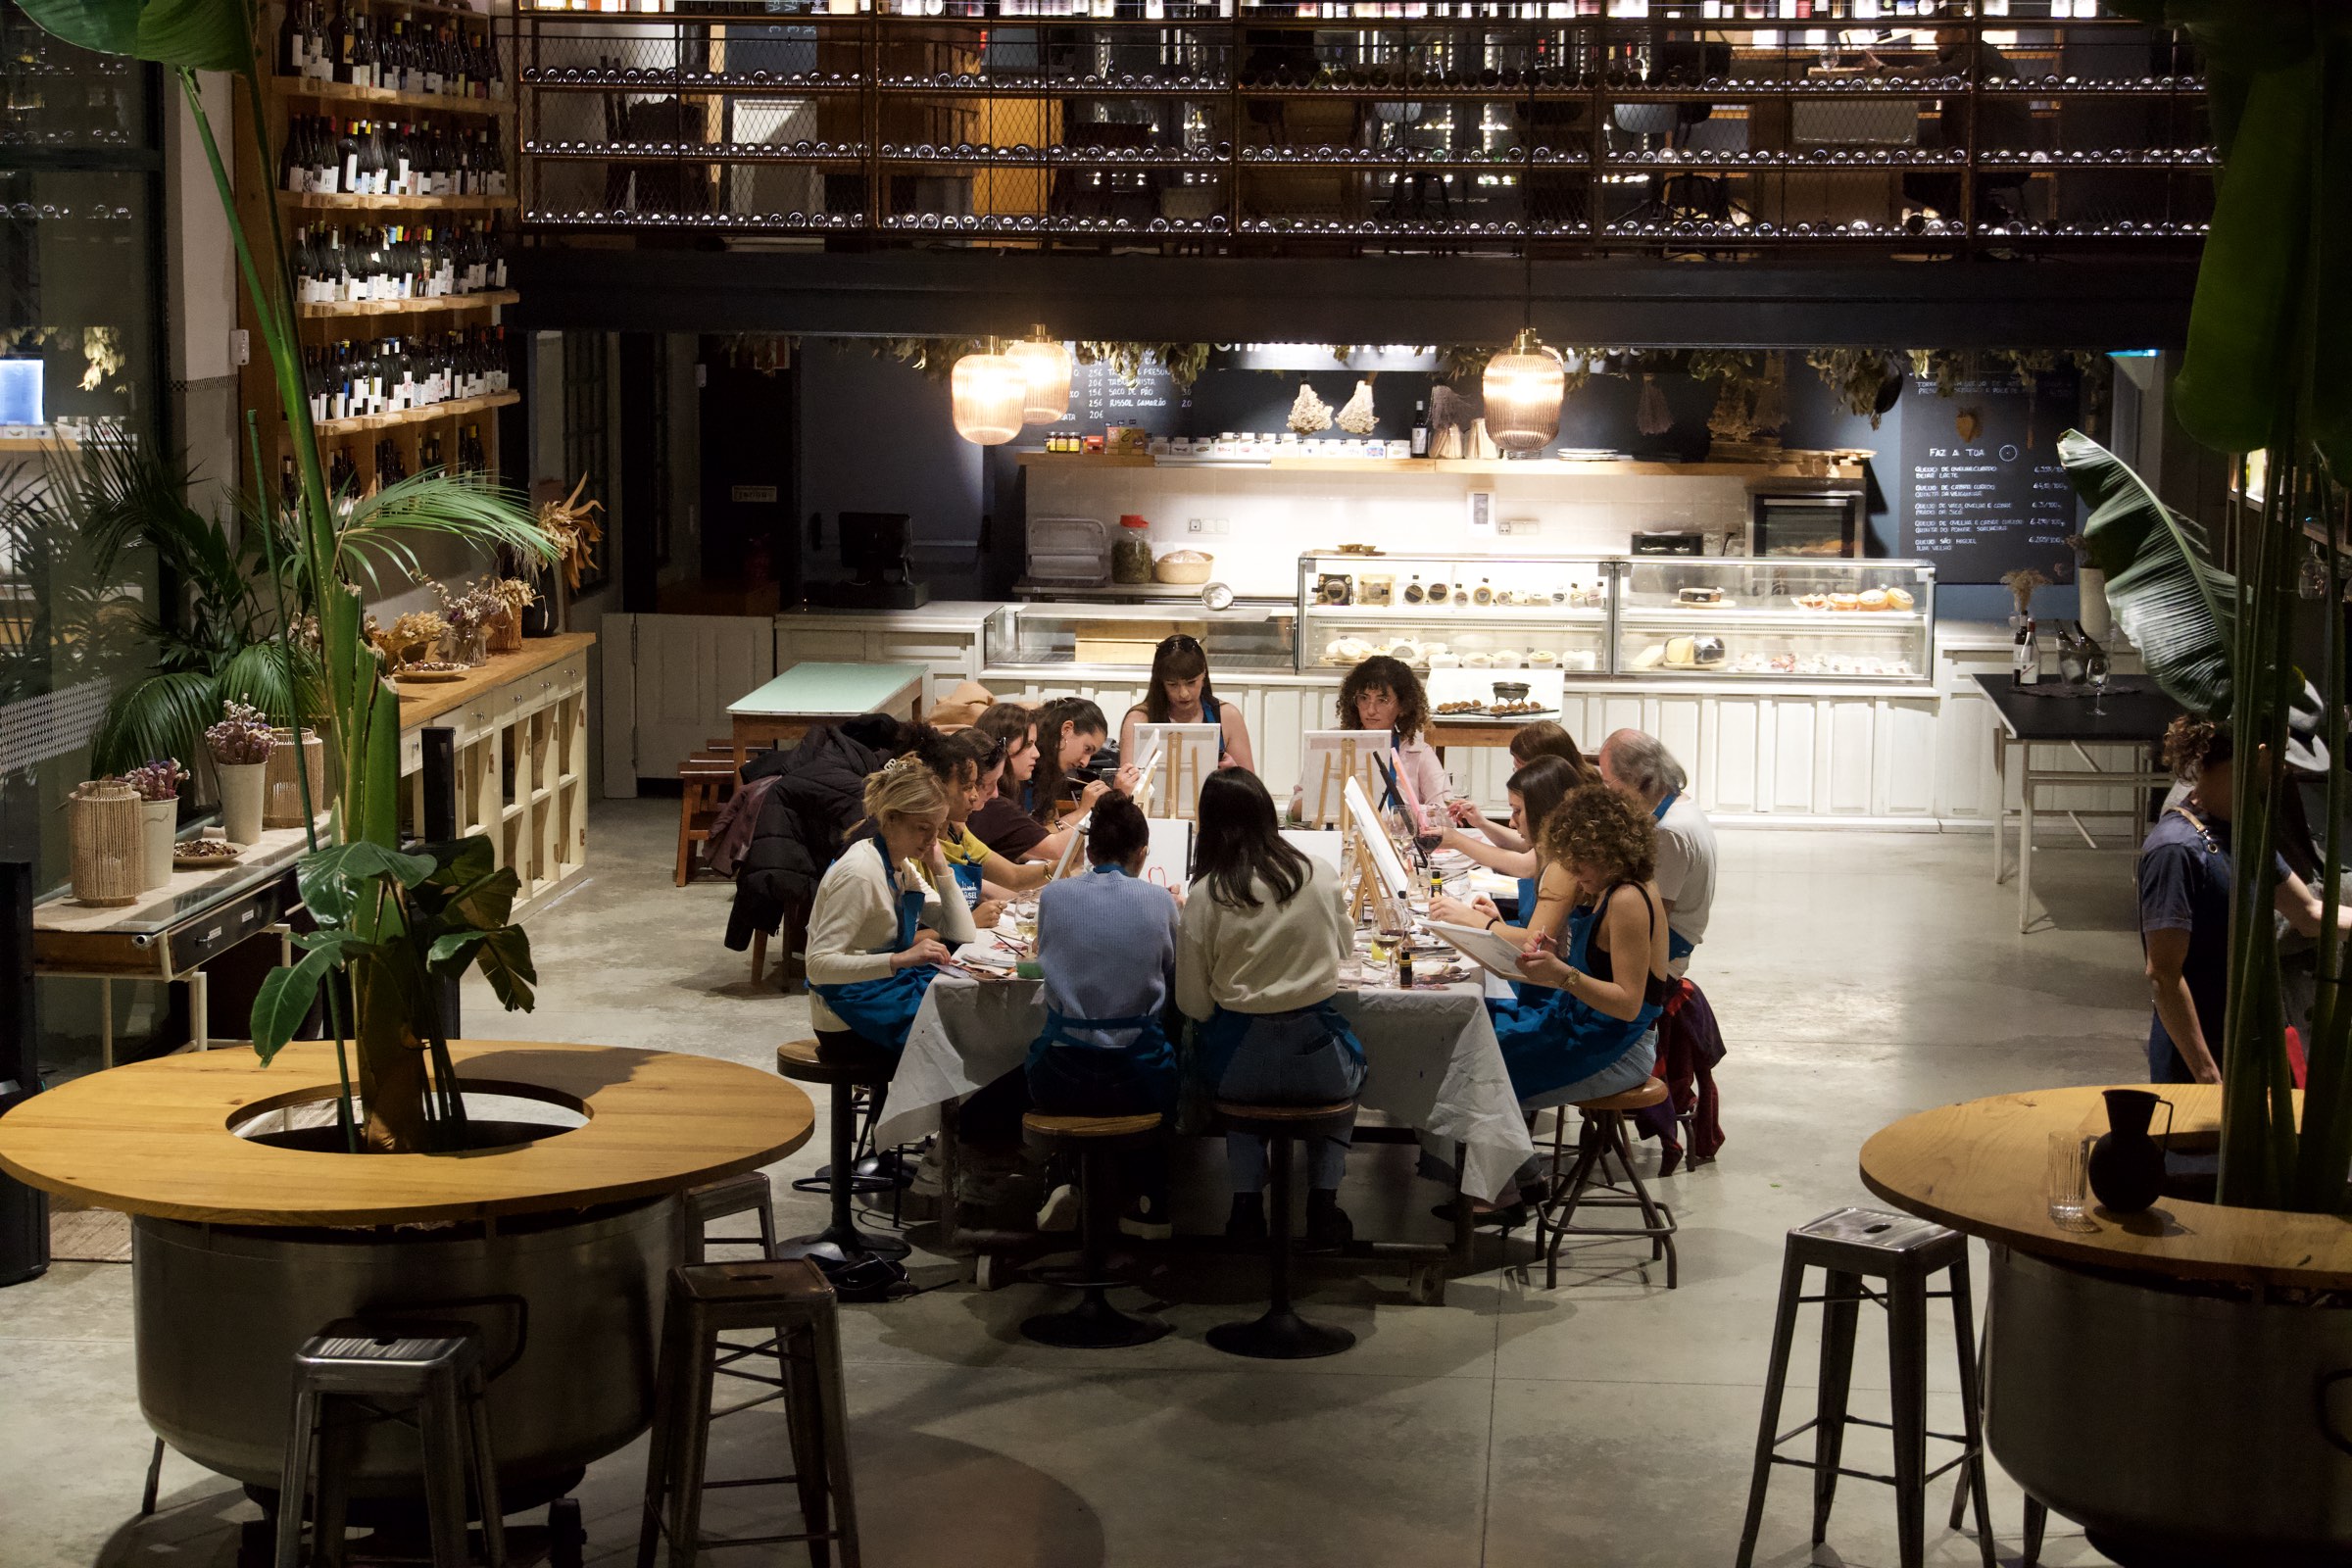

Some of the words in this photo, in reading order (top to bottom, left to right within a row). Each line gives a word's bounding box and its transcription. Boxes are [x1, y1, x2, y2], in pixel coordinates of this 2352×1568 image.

[1088, 368, 1103, 377] 25€
[1143, 368, 1171, 376] PRESUN
[1088, 378, 1103, 387] 20€
[1108, 387, 1125, 396] SACO
[1127, 387, 1137, 396] DE
[1140, 386, 1153, 396] PÃO
[1088, 399, 1103, 408] 25€
[1136, 397, 1167, 407] CAMARÃO
[1089, 410, 1103, 419] 20€
[1929, 448, 1947, 457] FAZ
